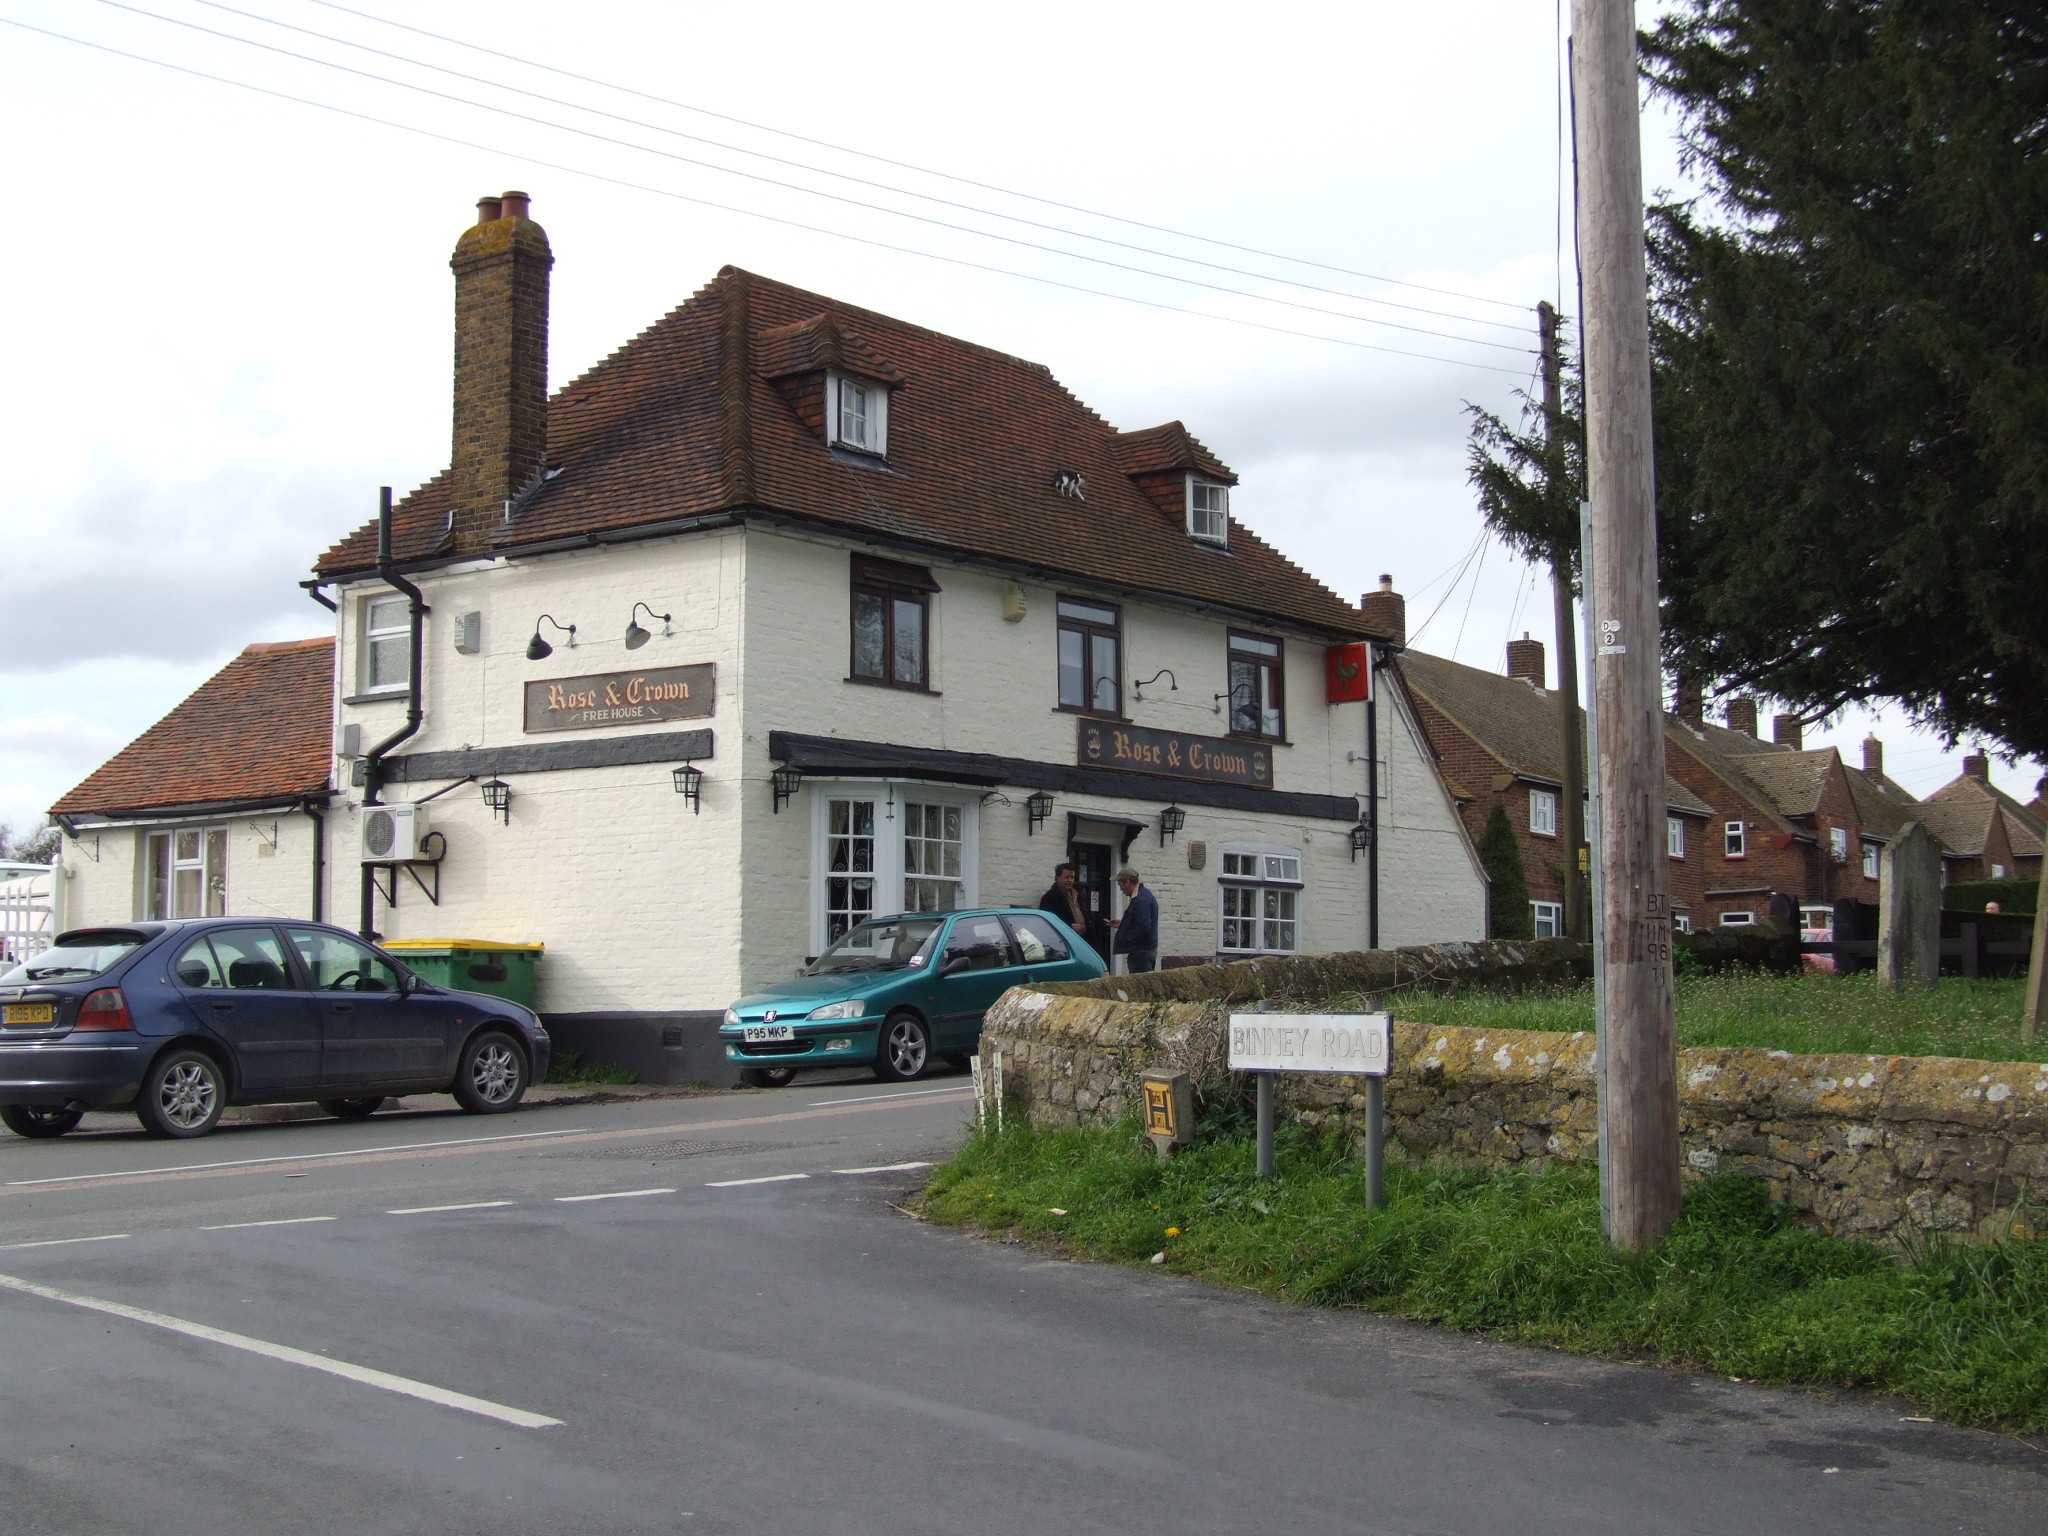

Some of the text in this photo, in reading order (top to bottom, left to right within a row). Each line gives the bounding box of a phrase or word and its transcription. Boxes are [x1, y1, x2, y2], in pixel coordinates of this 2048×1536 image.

[1606, 634, 1612, 643] 2
[547, 677, 690, 711] Rose & Crown
[582, 706, 644, 722] FREE HOUSE
[1113, 731, 1247, 775] Rose & Crown
[1647, 894, 1666, 913] BT
[1647, 943, 1667, 962] 98
[747, 1026, 788, 1039] P95 MKP
[1233, 1027, 1382, 1059] BINNEY ROAD
